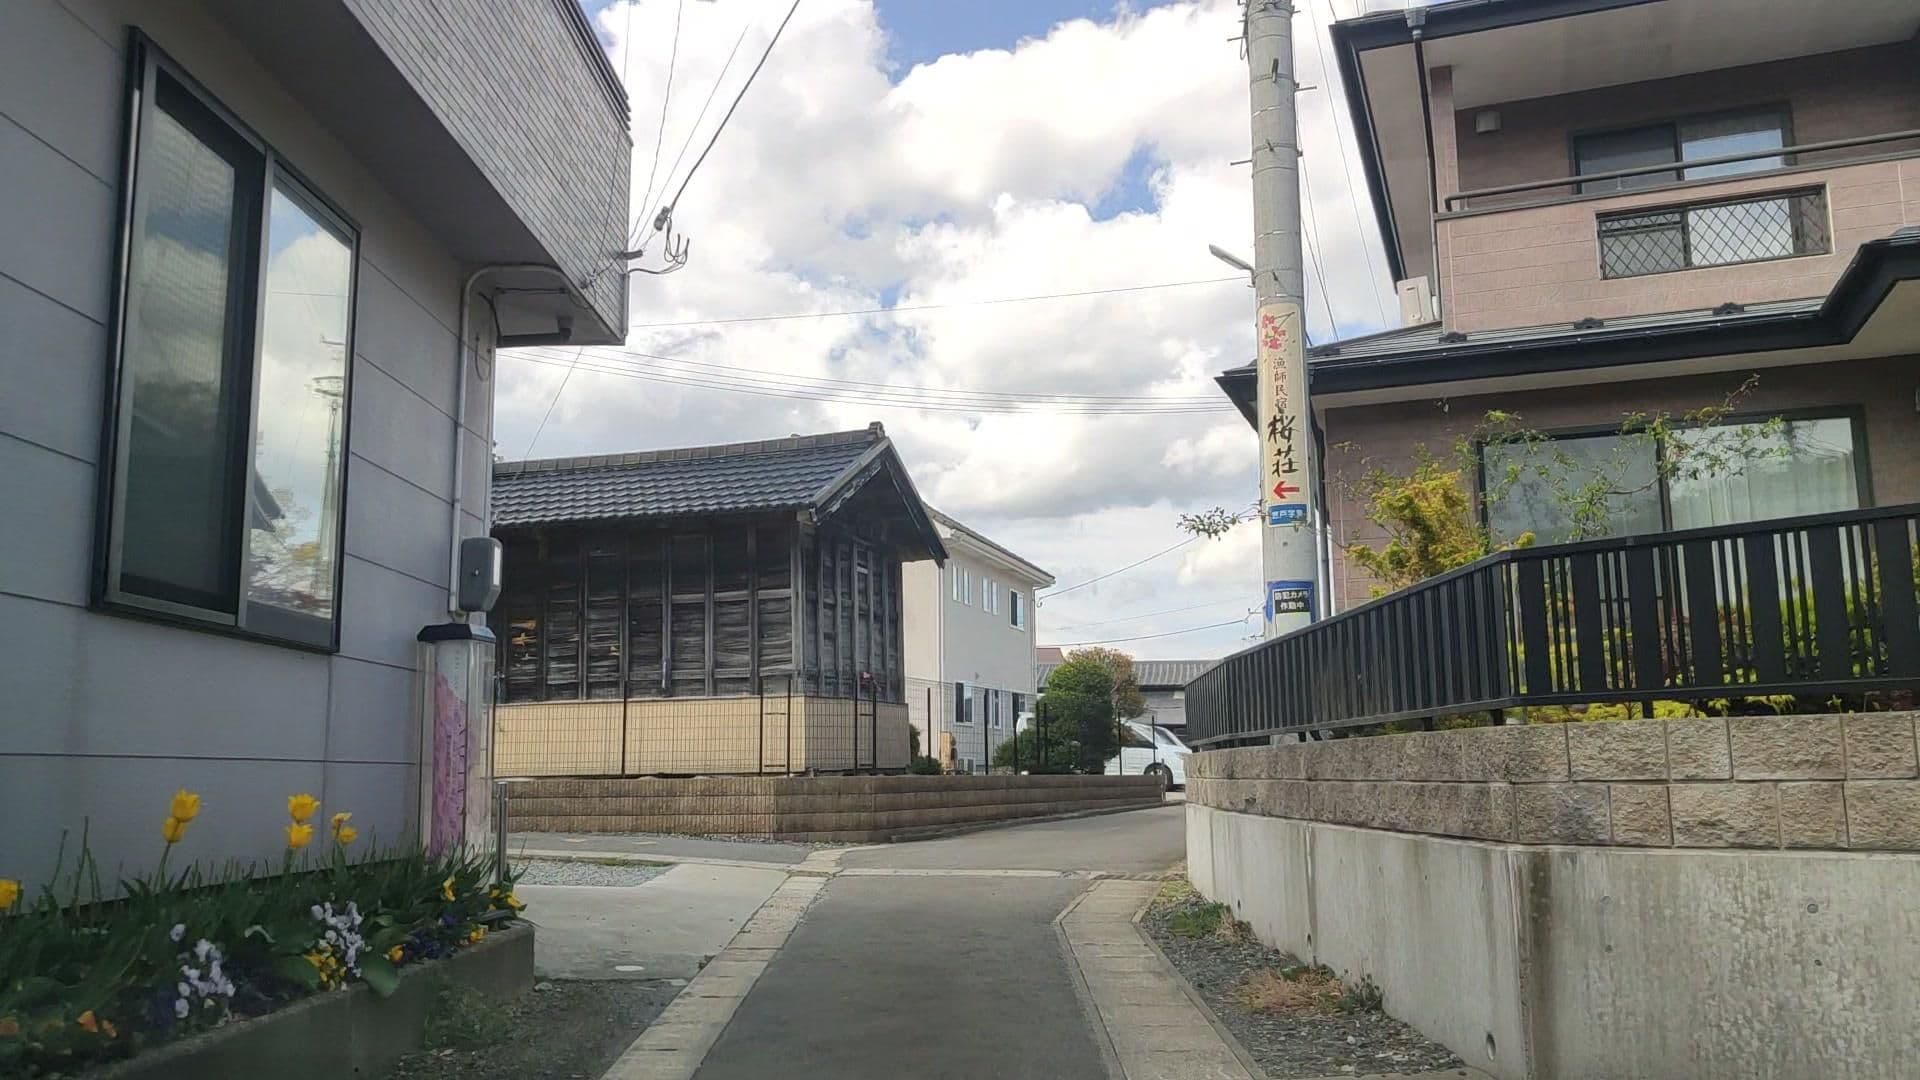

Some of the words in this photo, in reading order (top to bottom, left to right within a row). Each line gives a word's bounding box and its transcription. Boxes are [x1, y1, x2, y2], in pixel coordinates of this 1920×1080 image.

[1273, 357, 1288, 409] 漁師民宿
[1274, 590, 1308, 601] 防犯カメラ
[1280, 601, 1305, 611] 作動中
